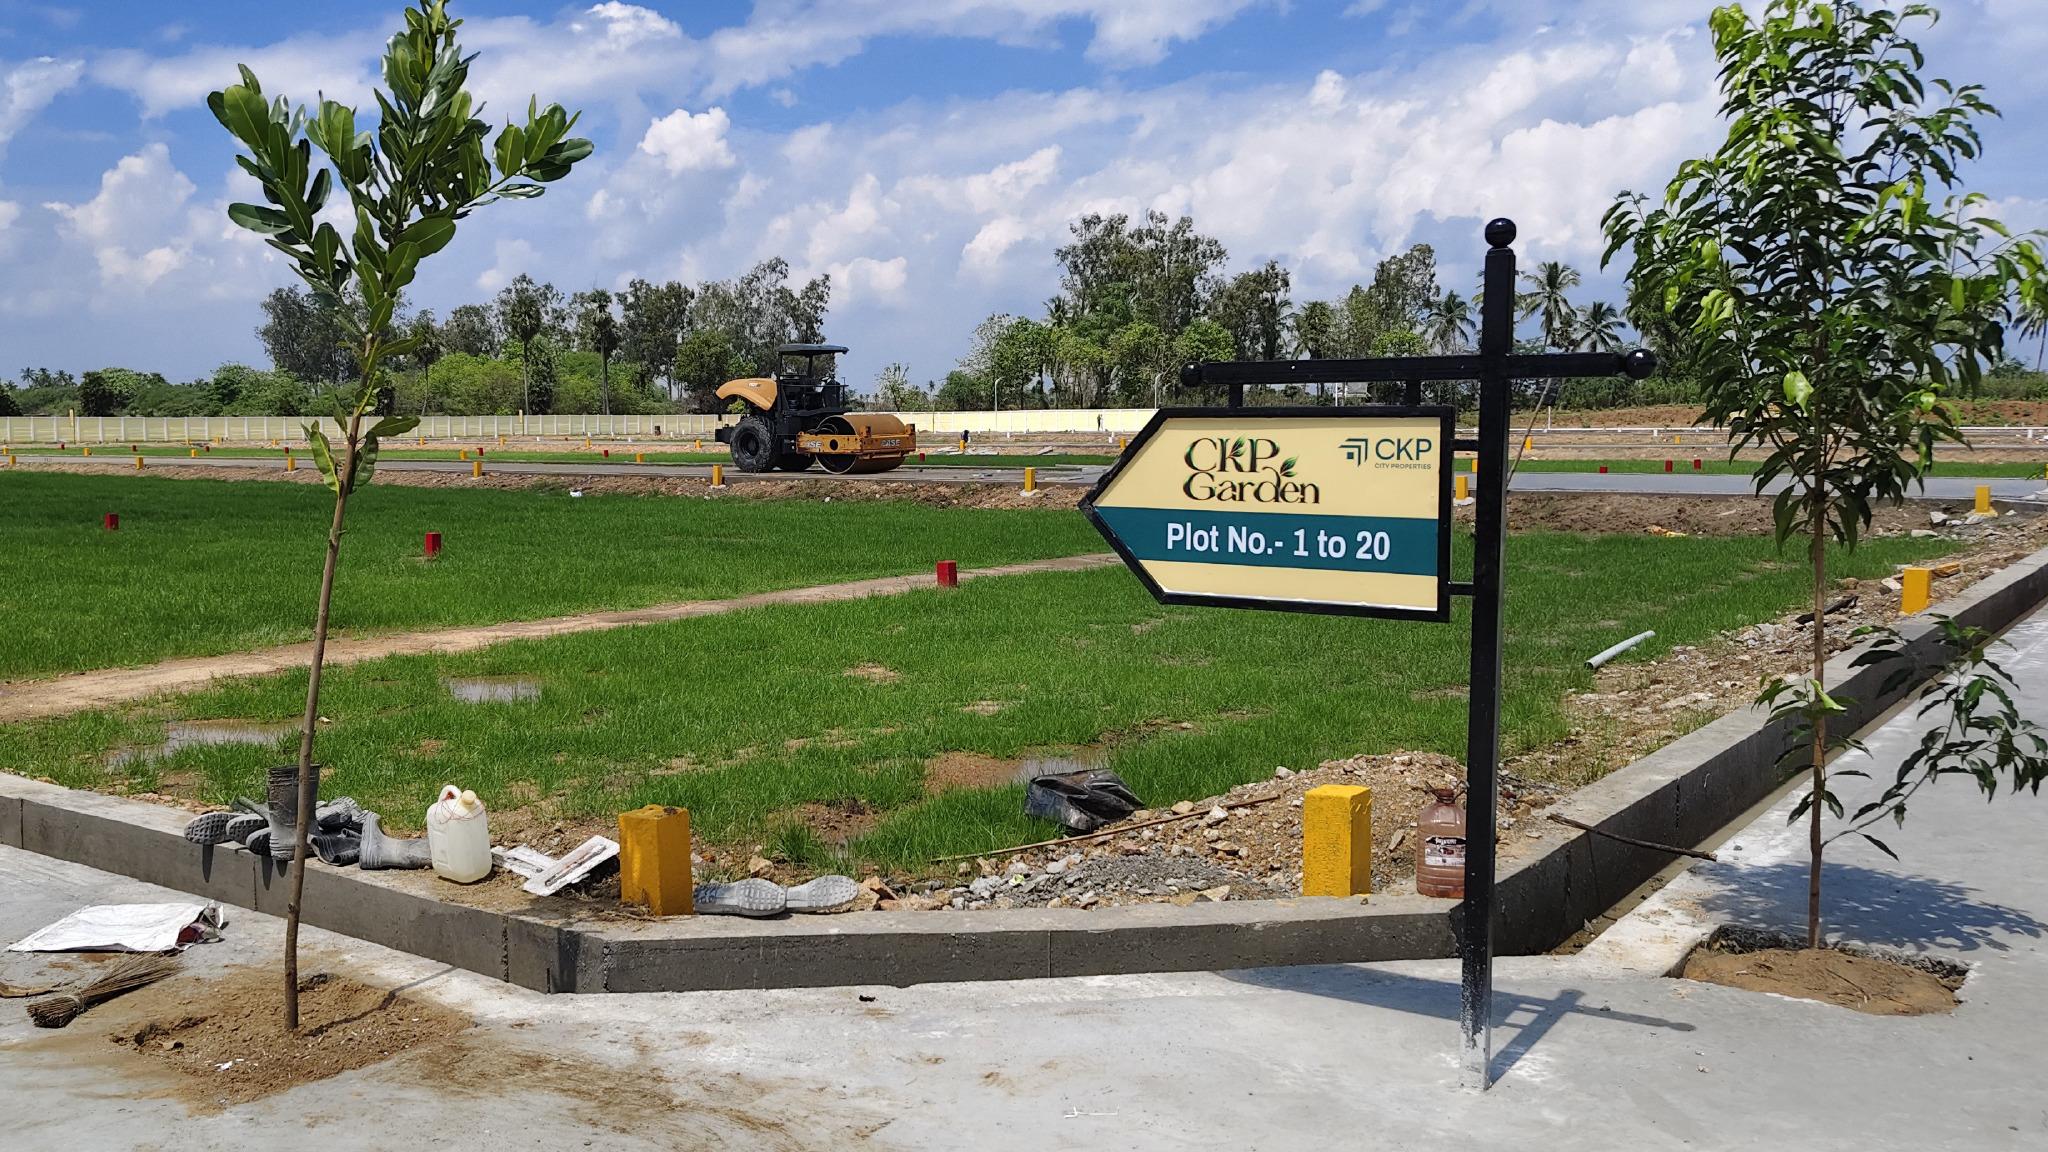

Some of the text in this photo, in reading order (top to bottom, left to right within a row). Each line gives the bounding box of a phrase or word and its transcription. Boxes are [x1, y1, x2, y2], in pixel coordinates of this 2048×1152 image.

[1184, 437, 1280, 473] CKP
[1375, 438, 1432, 461] CKP
[1182, 466, 1320, 504] Garden
[1167, 522, 1391, 561] Plot No.- 1 to 20
